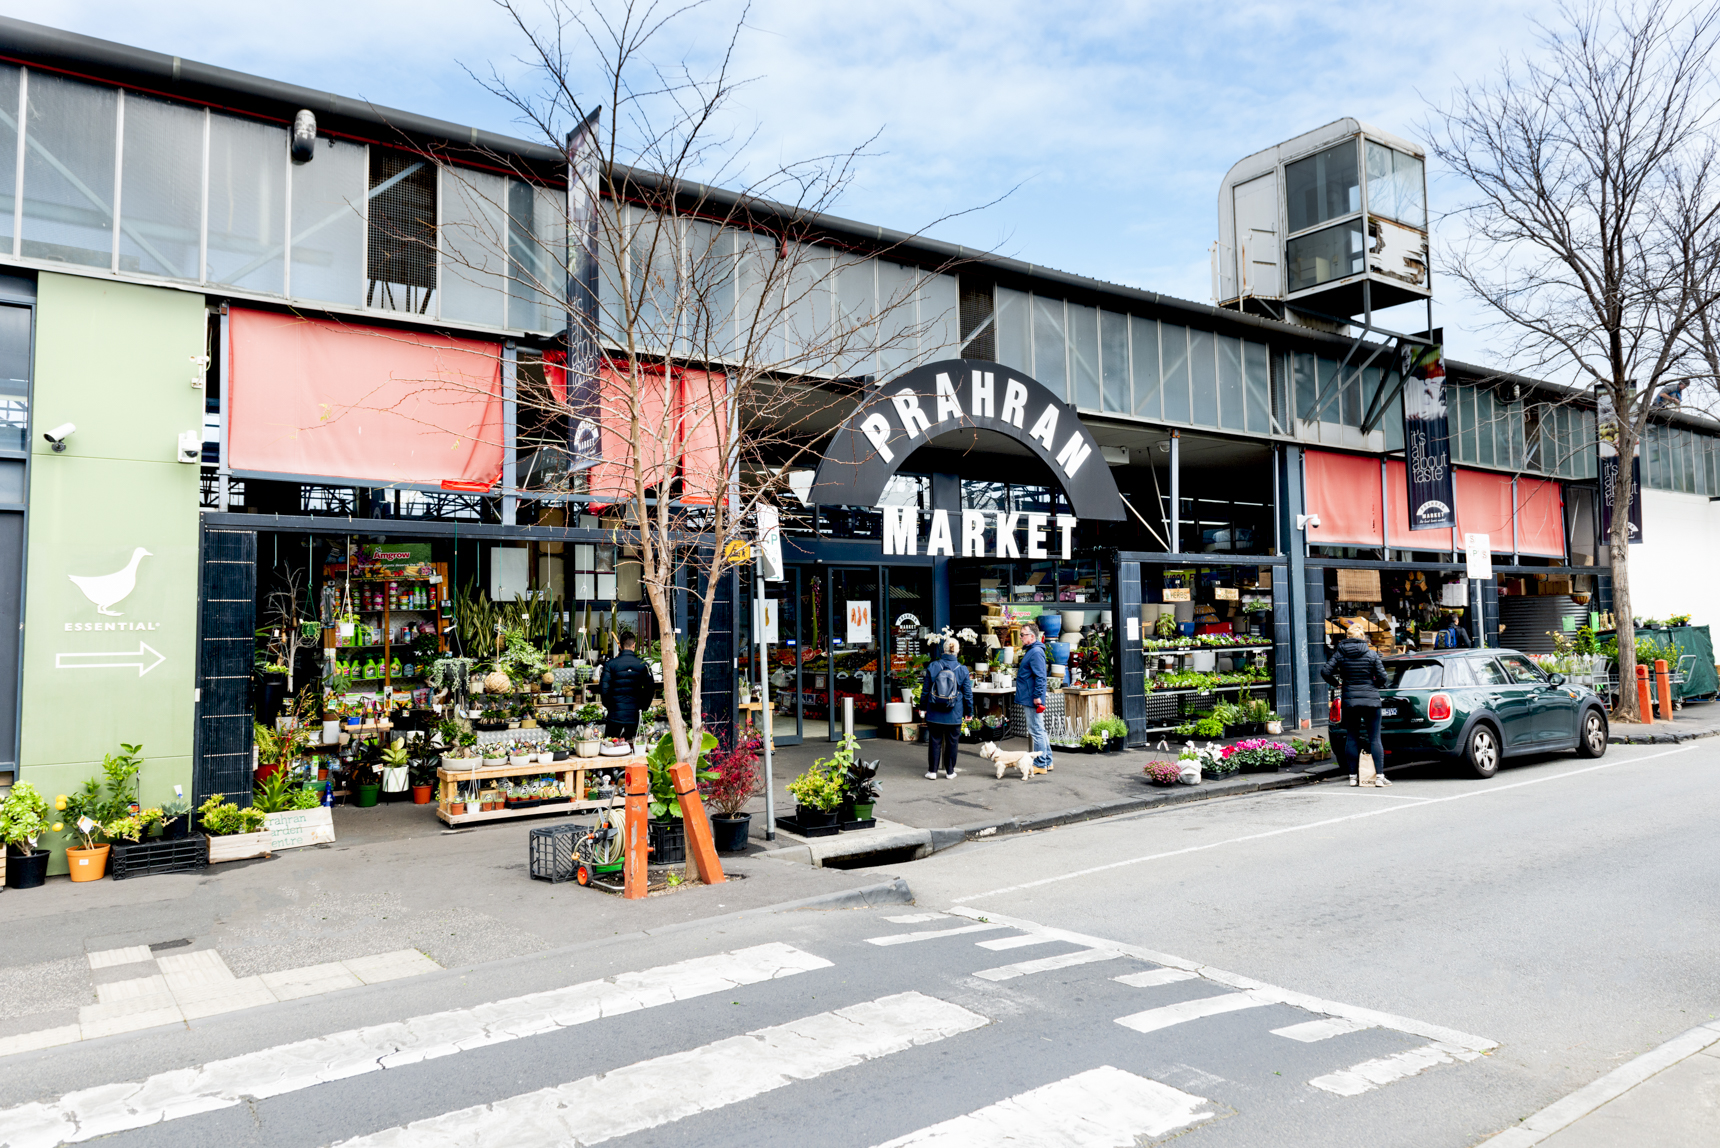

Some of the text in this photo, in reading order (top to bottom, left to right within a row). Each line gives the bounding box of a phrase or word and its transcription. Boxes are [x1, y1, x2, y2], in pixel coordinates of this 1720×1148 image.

[859, 369, 1092, 480] PRAHRAN
[1411, 430, 1426, 446] it's
[1411, 440, 1425, 459] all
[1412, 452, 1448, 470] about
[1412, 466, 1444, 483] taste
[882, 506, 1077, 560] MARKET
[373, 551, 410, 561] Amgrow
[263, 813, 307, 827] rahran
[269, 825, 303, 837] arden
[271, 837, 303, 848] entre
